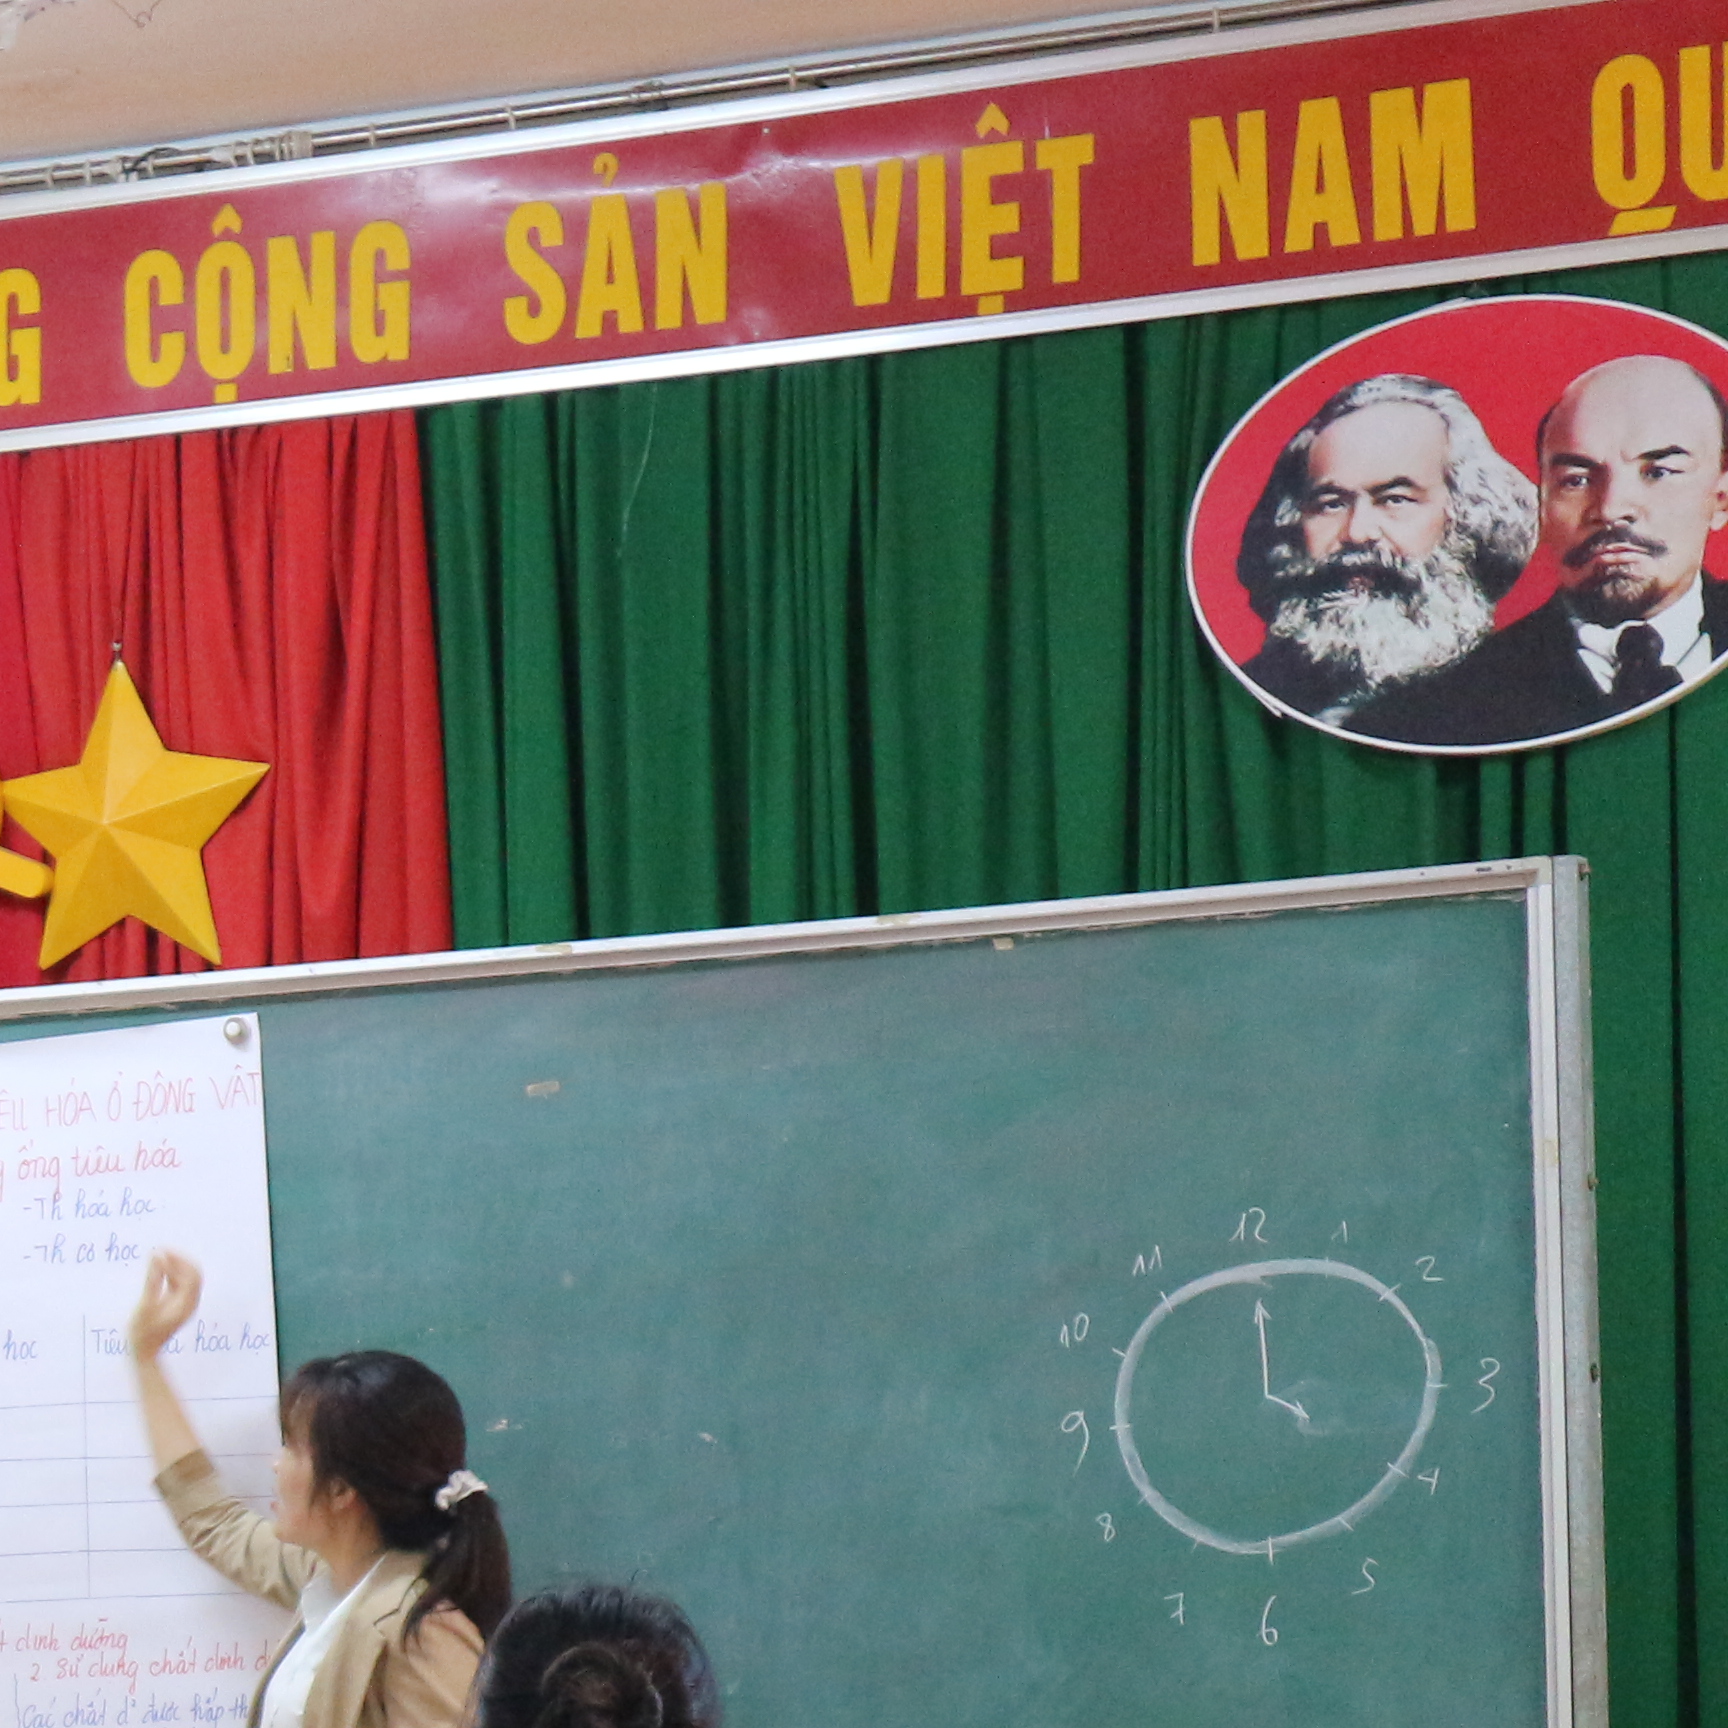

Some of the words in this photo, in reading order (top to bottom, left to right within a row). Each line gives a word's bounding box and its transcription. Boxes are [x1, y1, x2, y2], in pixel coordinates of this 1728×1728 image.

[125, 205, 412, 404] CỘNG
[503, 154, 728, 344] SẢN
[835, 105, 1095, 315] VIỆT
[1189, 79, 1477, 265] NAM
[46, 1077, 97, 1128] HÓA
[17, 1139, 62, 1201] ống
[71, 1145, 125, 1177] tiêu
[1229, 1206, 1268, 1243] 12
[1332, 1220, 1348, 1243] 1
[105, 1232, 140, 1266] học
[1132, 1244, 1162, 1277] 11
[1415, 1255, 1444, 1282] 2
[3, 1329, 38, 1364] học
[239, 1322, 270, 1355] học
[1060, 1312, 1090, 1348] 10
[1471, 1357, 1501, 1414] 3
[1060, 1410, 1090, 1476] 9
[1416, 1467, 1441, 1495] 4
[1095, 1512, 1116, 1542] 8
[1351, 1557, 1379, 1595] 5
[1163, 1592, 1185, 1625] 7
[1257, 1594, 1279, 1646] 6
[16, 1623, 60, 1652] dinh
[149, 1635, 197, 1677] chất
[204, 1641, 245, 1673] dinh
[229, 1694, 249, 1721] th
